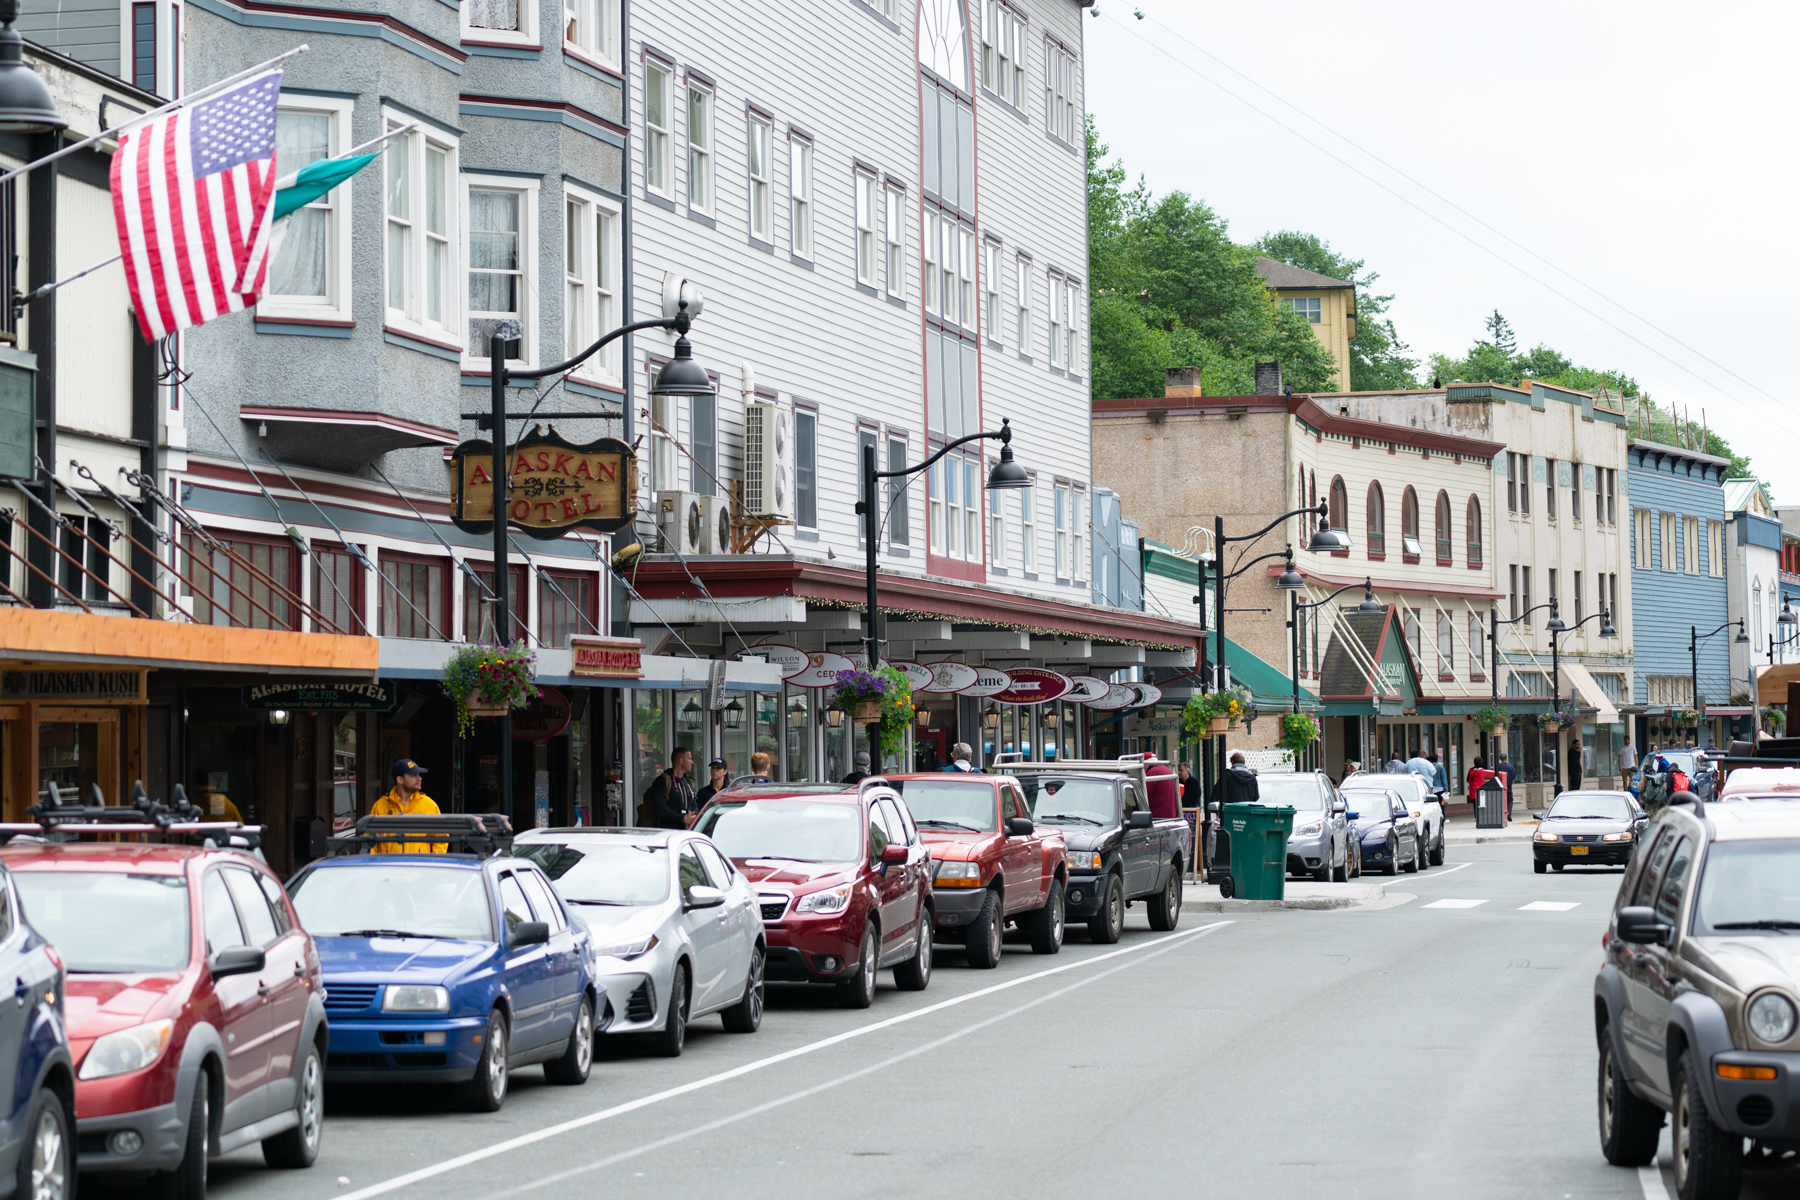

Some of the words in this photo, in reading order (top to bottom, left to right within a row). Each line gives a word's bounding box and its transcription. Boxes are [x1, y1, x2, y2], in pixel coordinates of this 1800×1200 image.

[470, 451, 617, 485] AASKAN
[488, 492, 603, 522] OTEL
[816, 670, 841, 678] CEDA
[910, 665, 928, 677] DELI
[955, 664, 968, 673] Spice
[28, 672, 95, 693] ALASKAN
[99, 672, 139, 693] KUSH
[974, 677, 1003, 687] eme
[1034, 670, 1063, 685] ENTRANCE
[298, 690, 320, 700] Est.
[320, 690, 339, 700] 1913
[303, 701, 323, 709] Register
